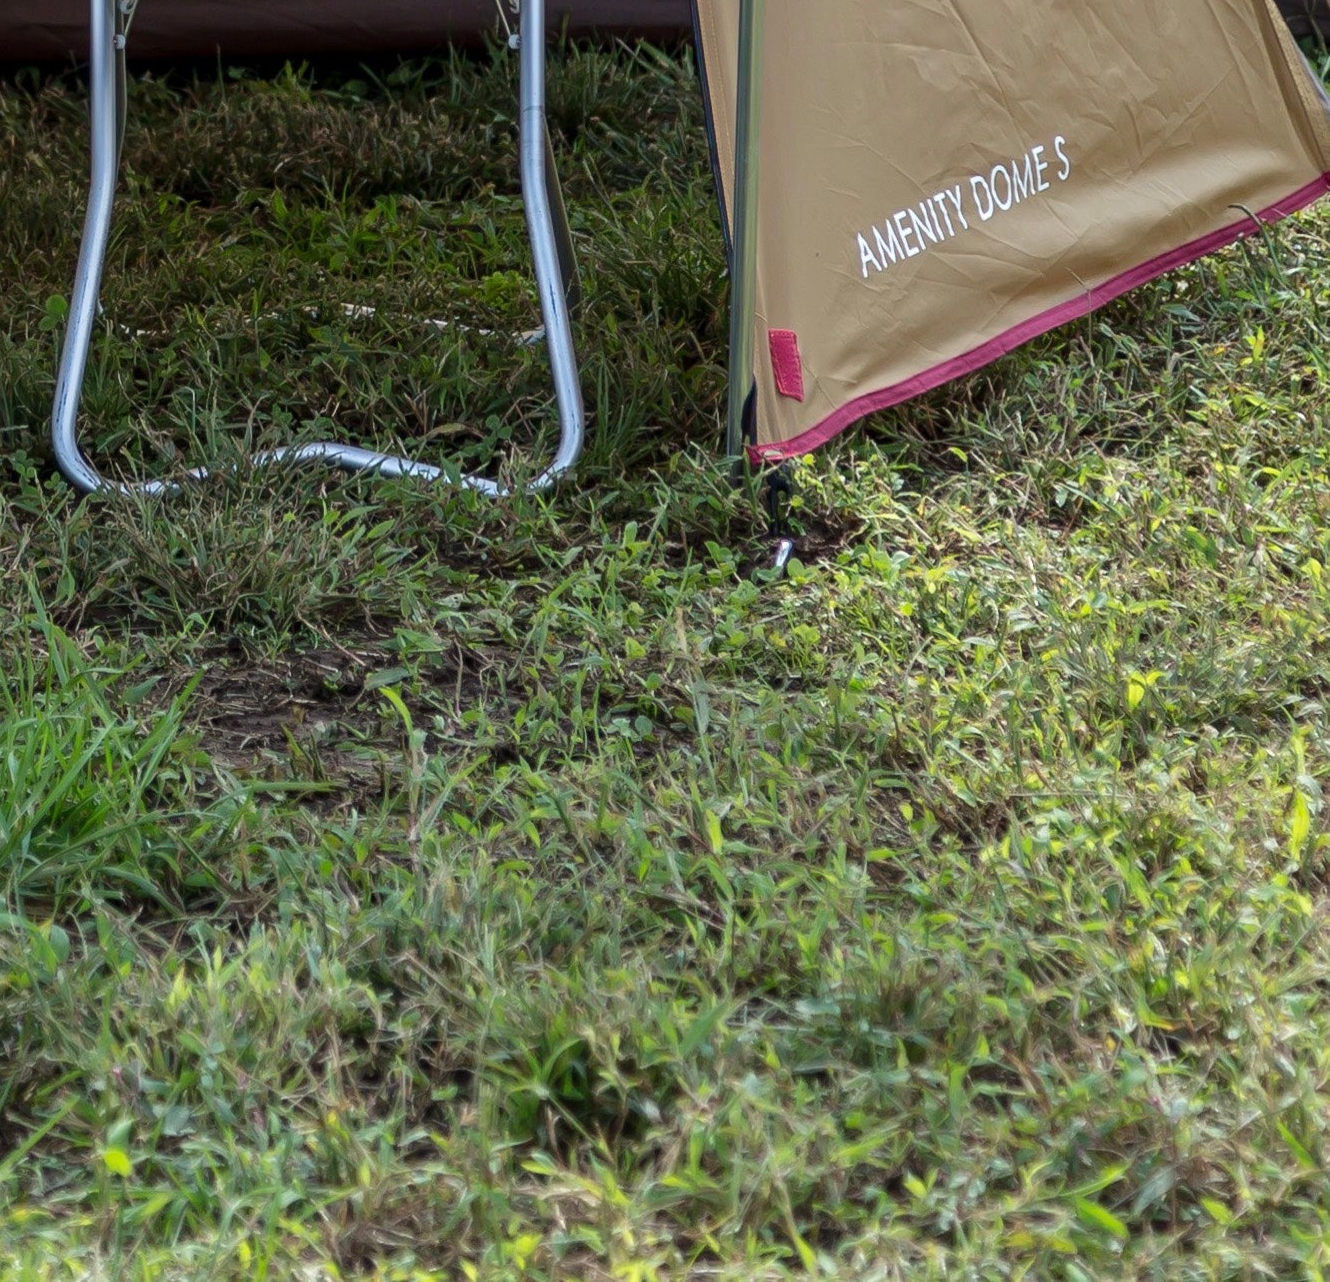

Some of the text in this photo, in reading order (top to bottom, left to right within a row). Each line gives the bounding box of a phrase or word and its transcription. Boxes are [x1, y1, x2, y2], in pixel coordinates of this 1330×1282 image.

[855, 135, 1071, 278] AMENITY DOME S
